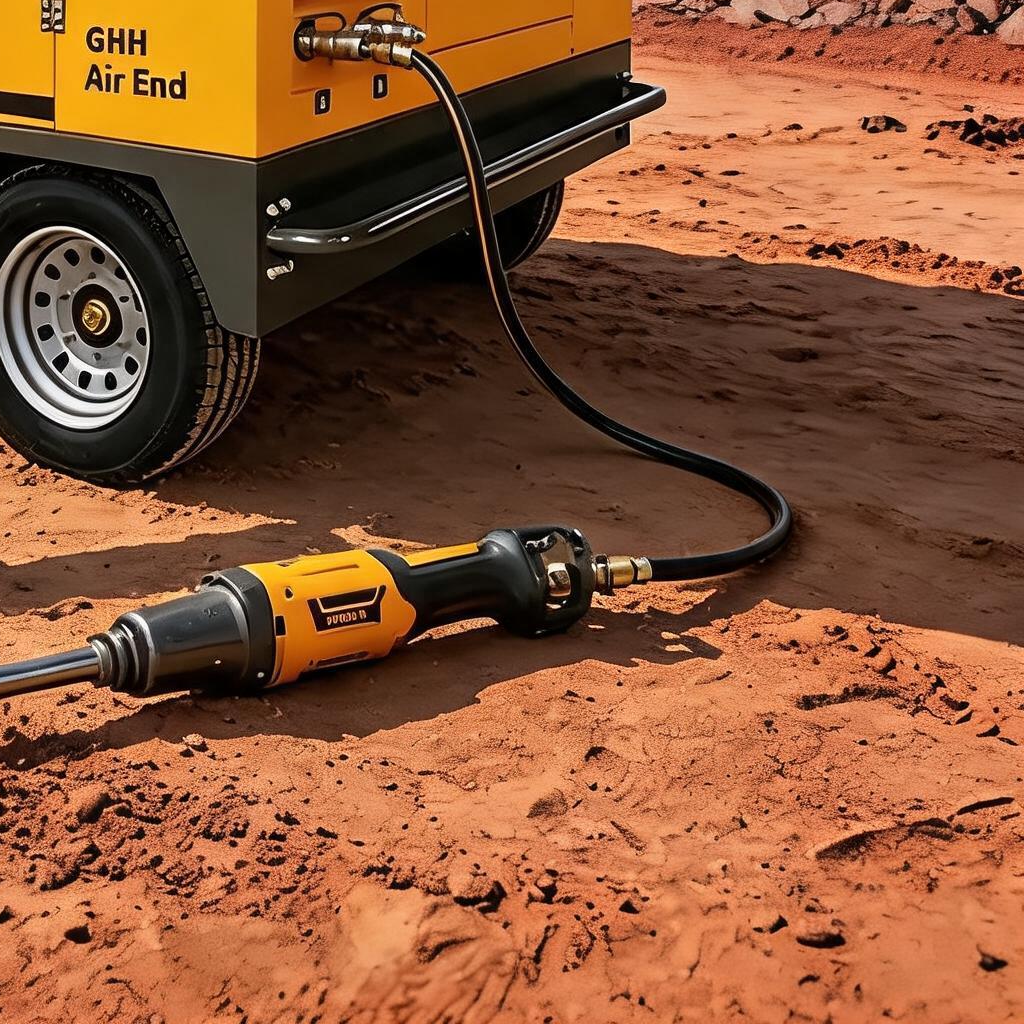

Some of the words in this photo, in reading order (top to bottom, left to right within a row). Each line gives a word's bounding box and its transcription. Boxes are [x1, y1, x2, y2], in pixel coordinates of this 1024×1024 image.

[85, 26, 147, 56] GHH
[84, 63, 126, 94] Air
[132, 68, 187, 100] End
